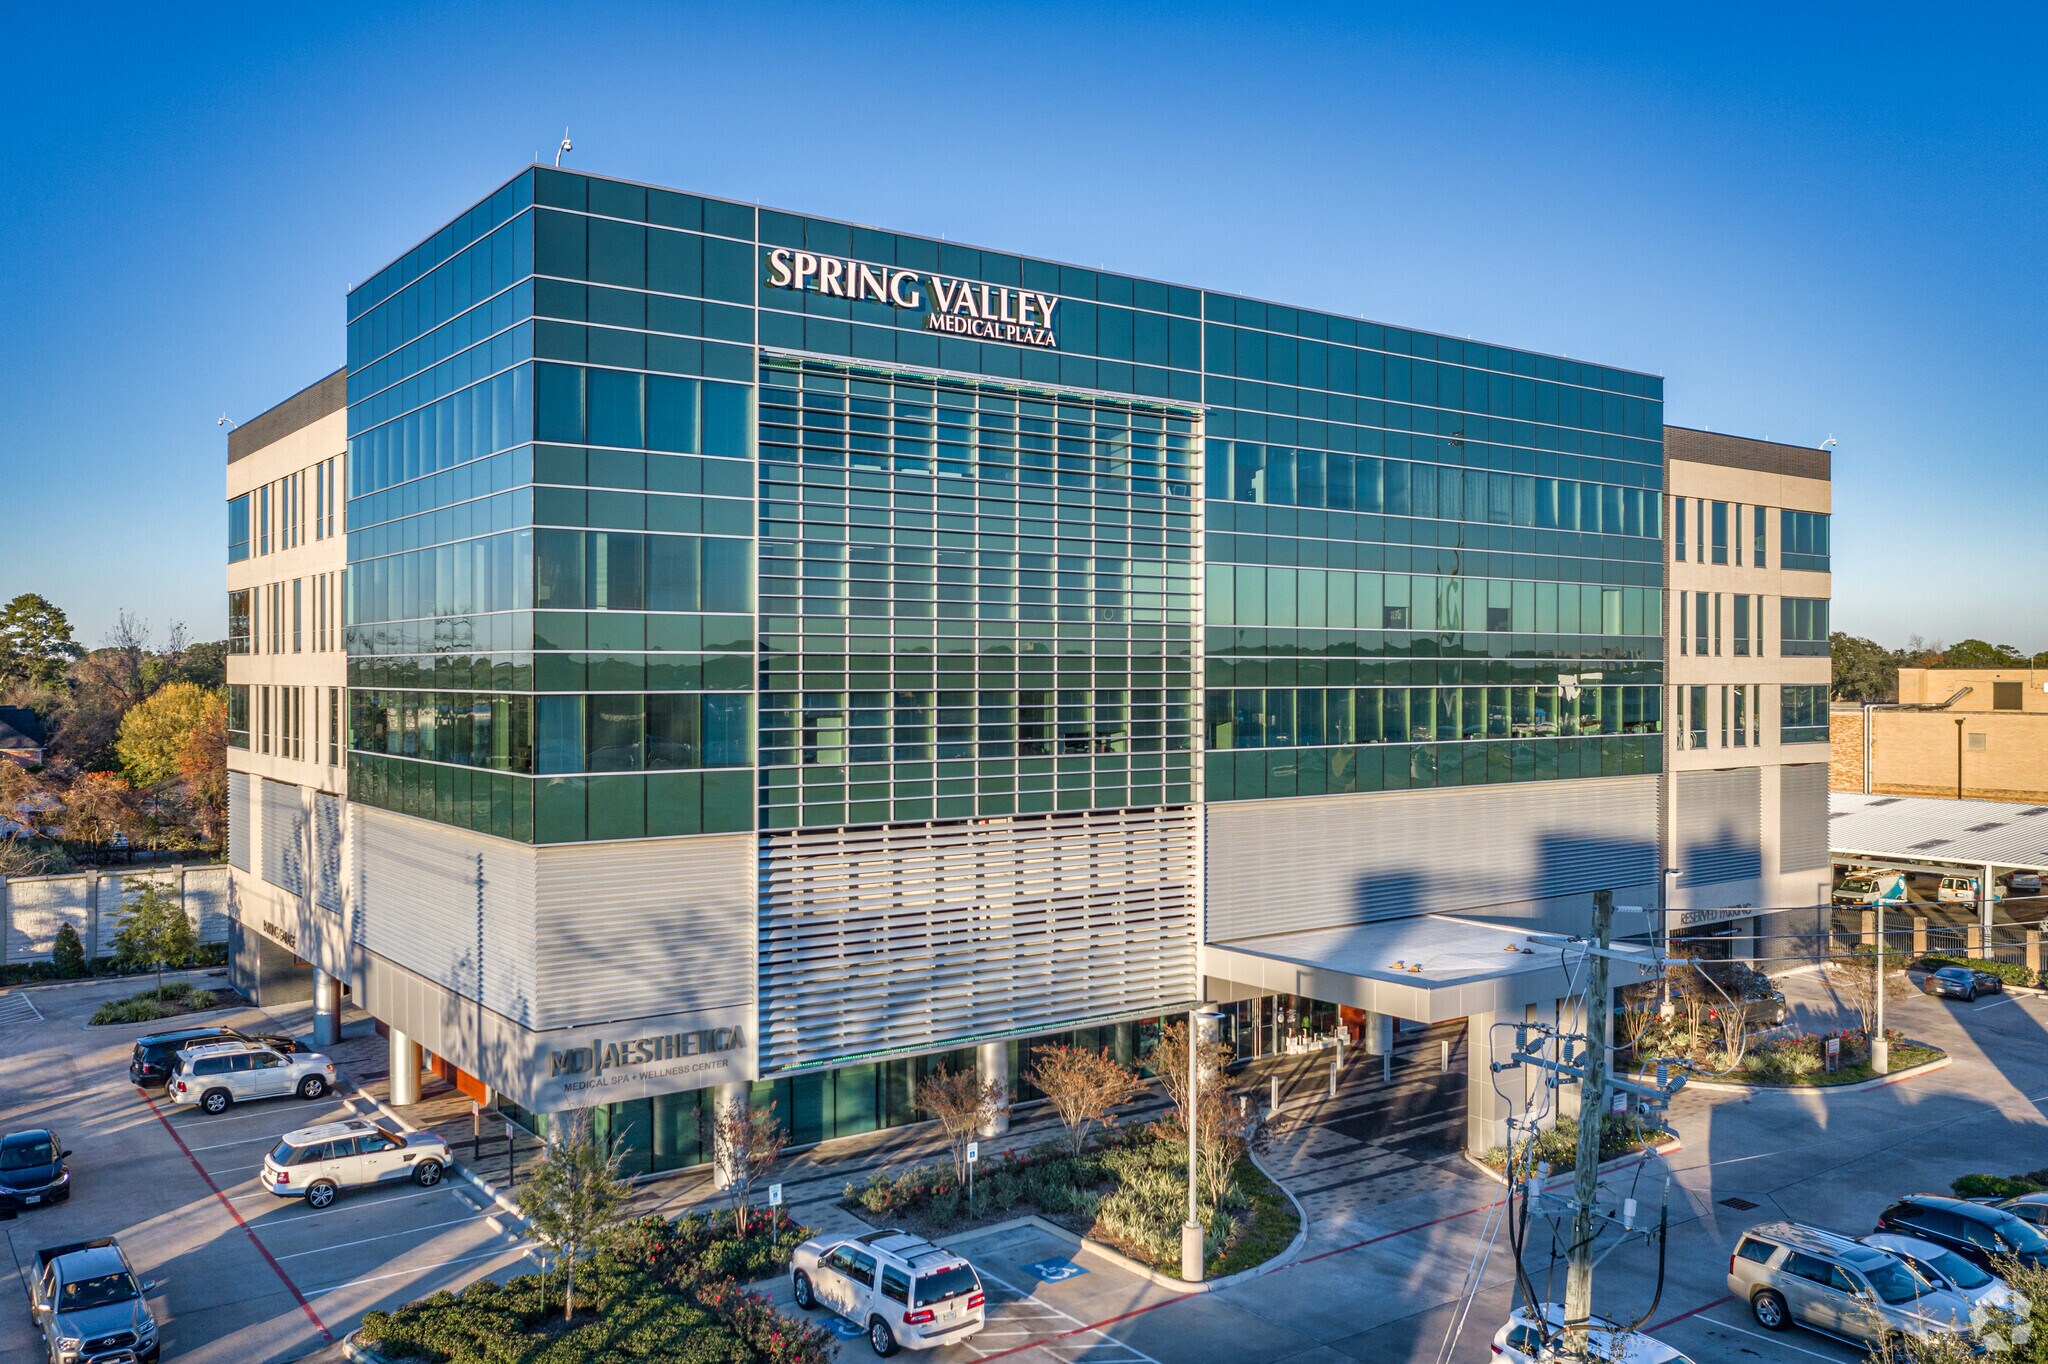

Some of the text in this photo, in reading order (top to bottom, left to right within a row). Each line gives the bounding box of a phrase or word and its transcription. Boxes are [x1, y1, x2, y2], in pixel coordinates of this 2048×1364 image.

[768, 249, 1059, 329] SPRING VALLEY
[928, 313, 1057, 347] MEDICAL PLAZA
[1680, 908, 1717, 925] RESERVED
[564, 1079, 609, 1092] MEDICAL
[611, 1074, 630, 1085] SPA
[639, 1064, 690, 1081] WELLNESS
[691, 1059, 729, 1072] CENTER
